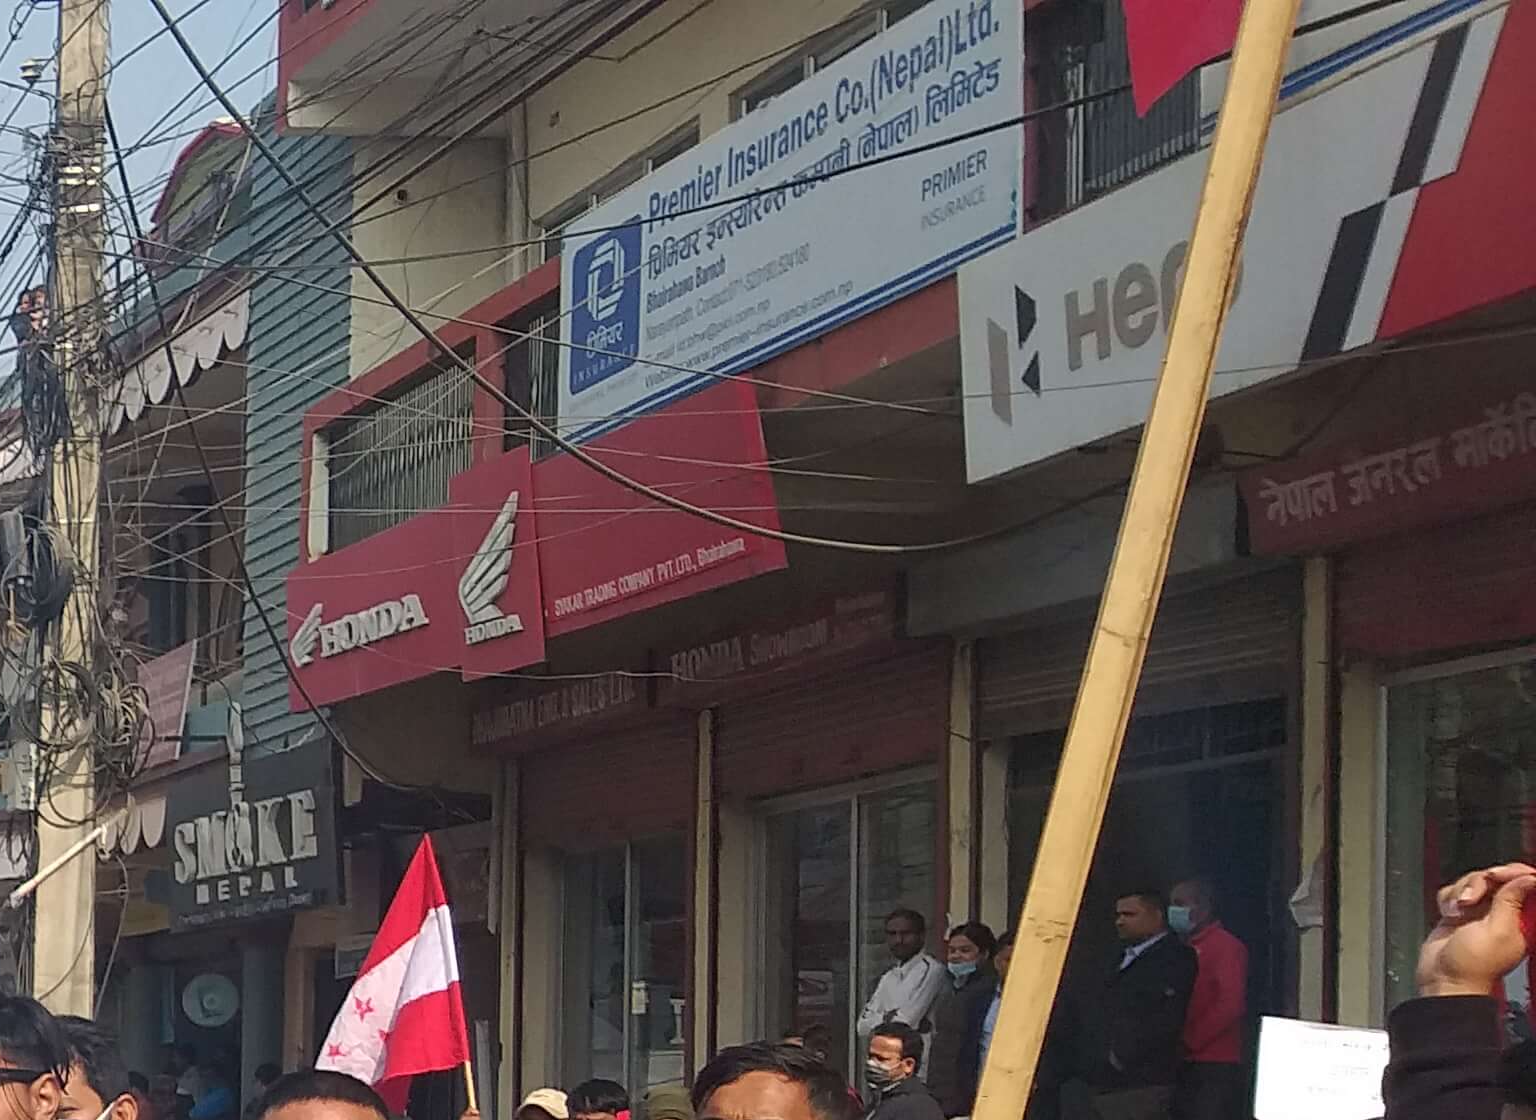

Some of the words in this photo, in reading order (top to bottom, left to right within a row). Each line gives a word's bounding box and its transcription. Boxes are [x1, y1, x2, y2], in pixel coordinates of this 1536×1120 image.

[926, 58, 1001, 127] लिमिटेड
[649, 162, 722, 233] Premier
[728, 99, 829, 187] Insurance
[1064, 240, 1243, 372] Her
[1259, 471, 1338, 527] नेपाल
[1342, 436, 1442, 506] जनरल
[319, 594, 430, 658] HONDA
[464, 614, 525, 645] HONDA
[196, 866, 298, 904] NEPAL
